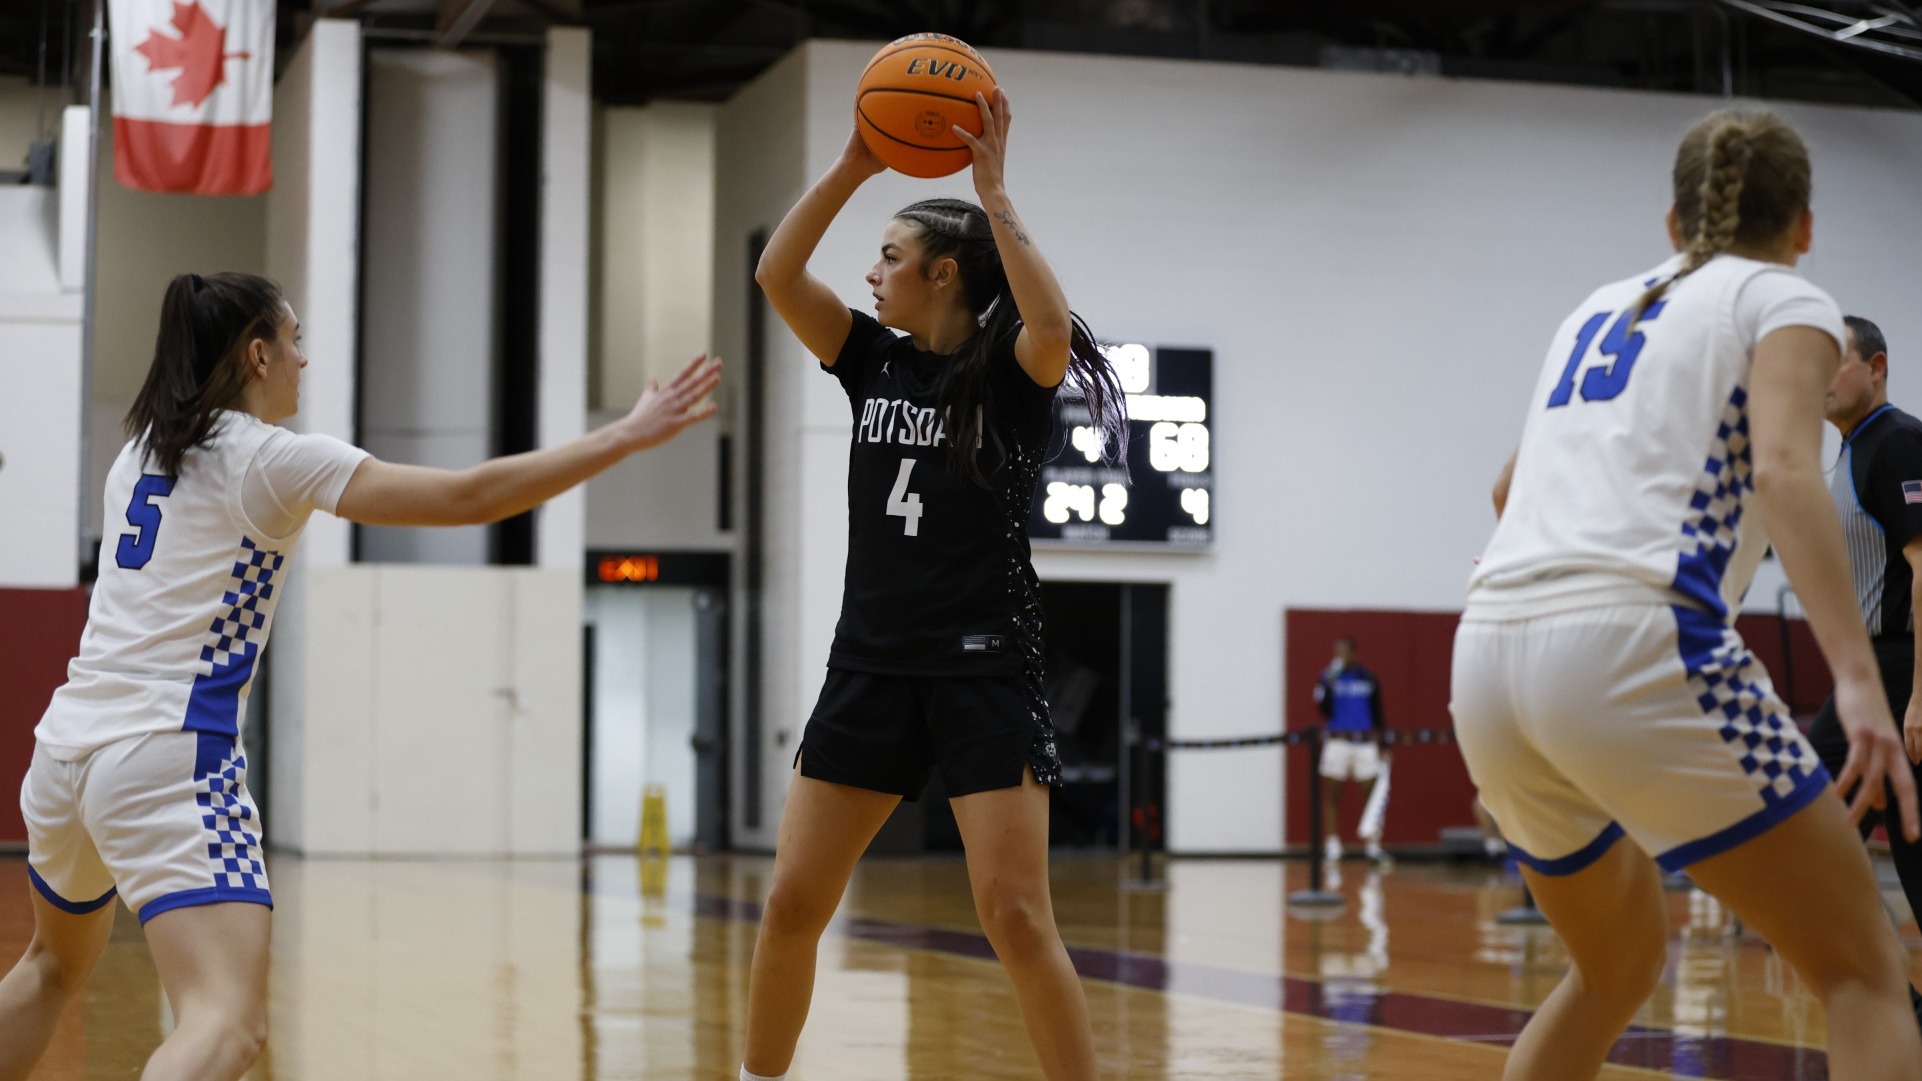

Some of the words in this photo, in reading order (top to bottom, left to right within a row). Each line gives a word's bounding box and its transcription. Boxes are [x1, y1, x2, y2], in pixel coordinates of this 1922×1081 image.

[906, 58, 968, 81] EVO
[1546, 299, 1668, 409] 15
[1150, 422, 1209, 472] 68
[115, 473, 179, 570] 5
[886, 458, 924, 537] 4
[991, 639, 1000, 648] M
